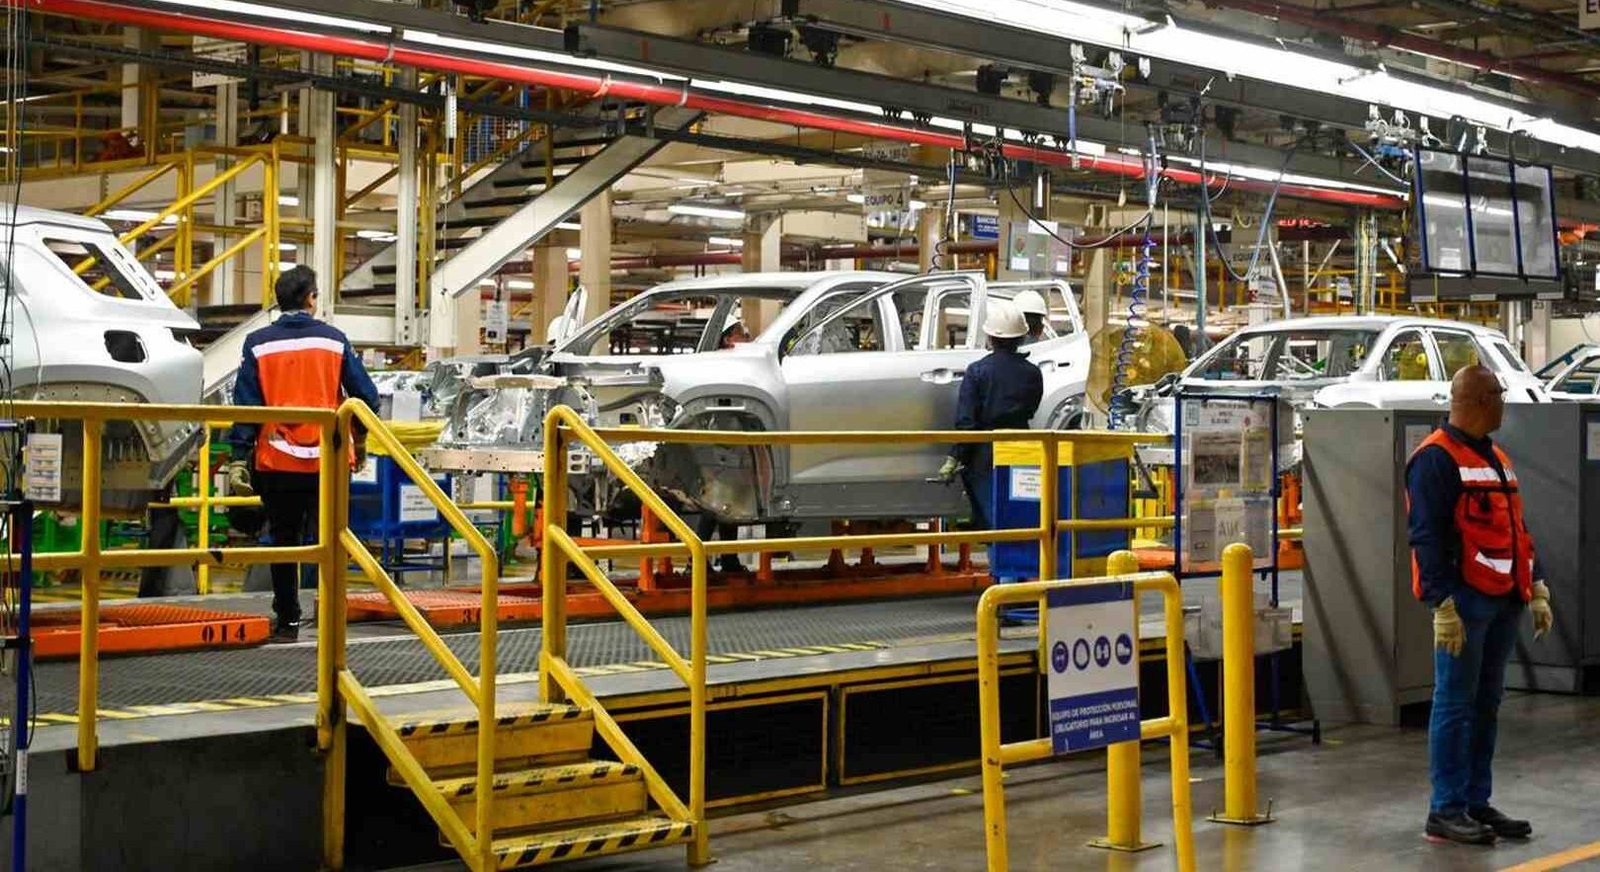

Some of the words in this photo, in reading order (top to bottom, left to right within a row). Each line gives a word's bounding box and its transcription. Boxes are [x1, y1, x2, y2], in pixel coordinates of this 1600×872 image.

[864, 194, 893, 206] EQUIPO
[896, 190, 903, 207] 4
[202, 623, 246, 642] 014
[1071, 708, 1078, 717] DE
